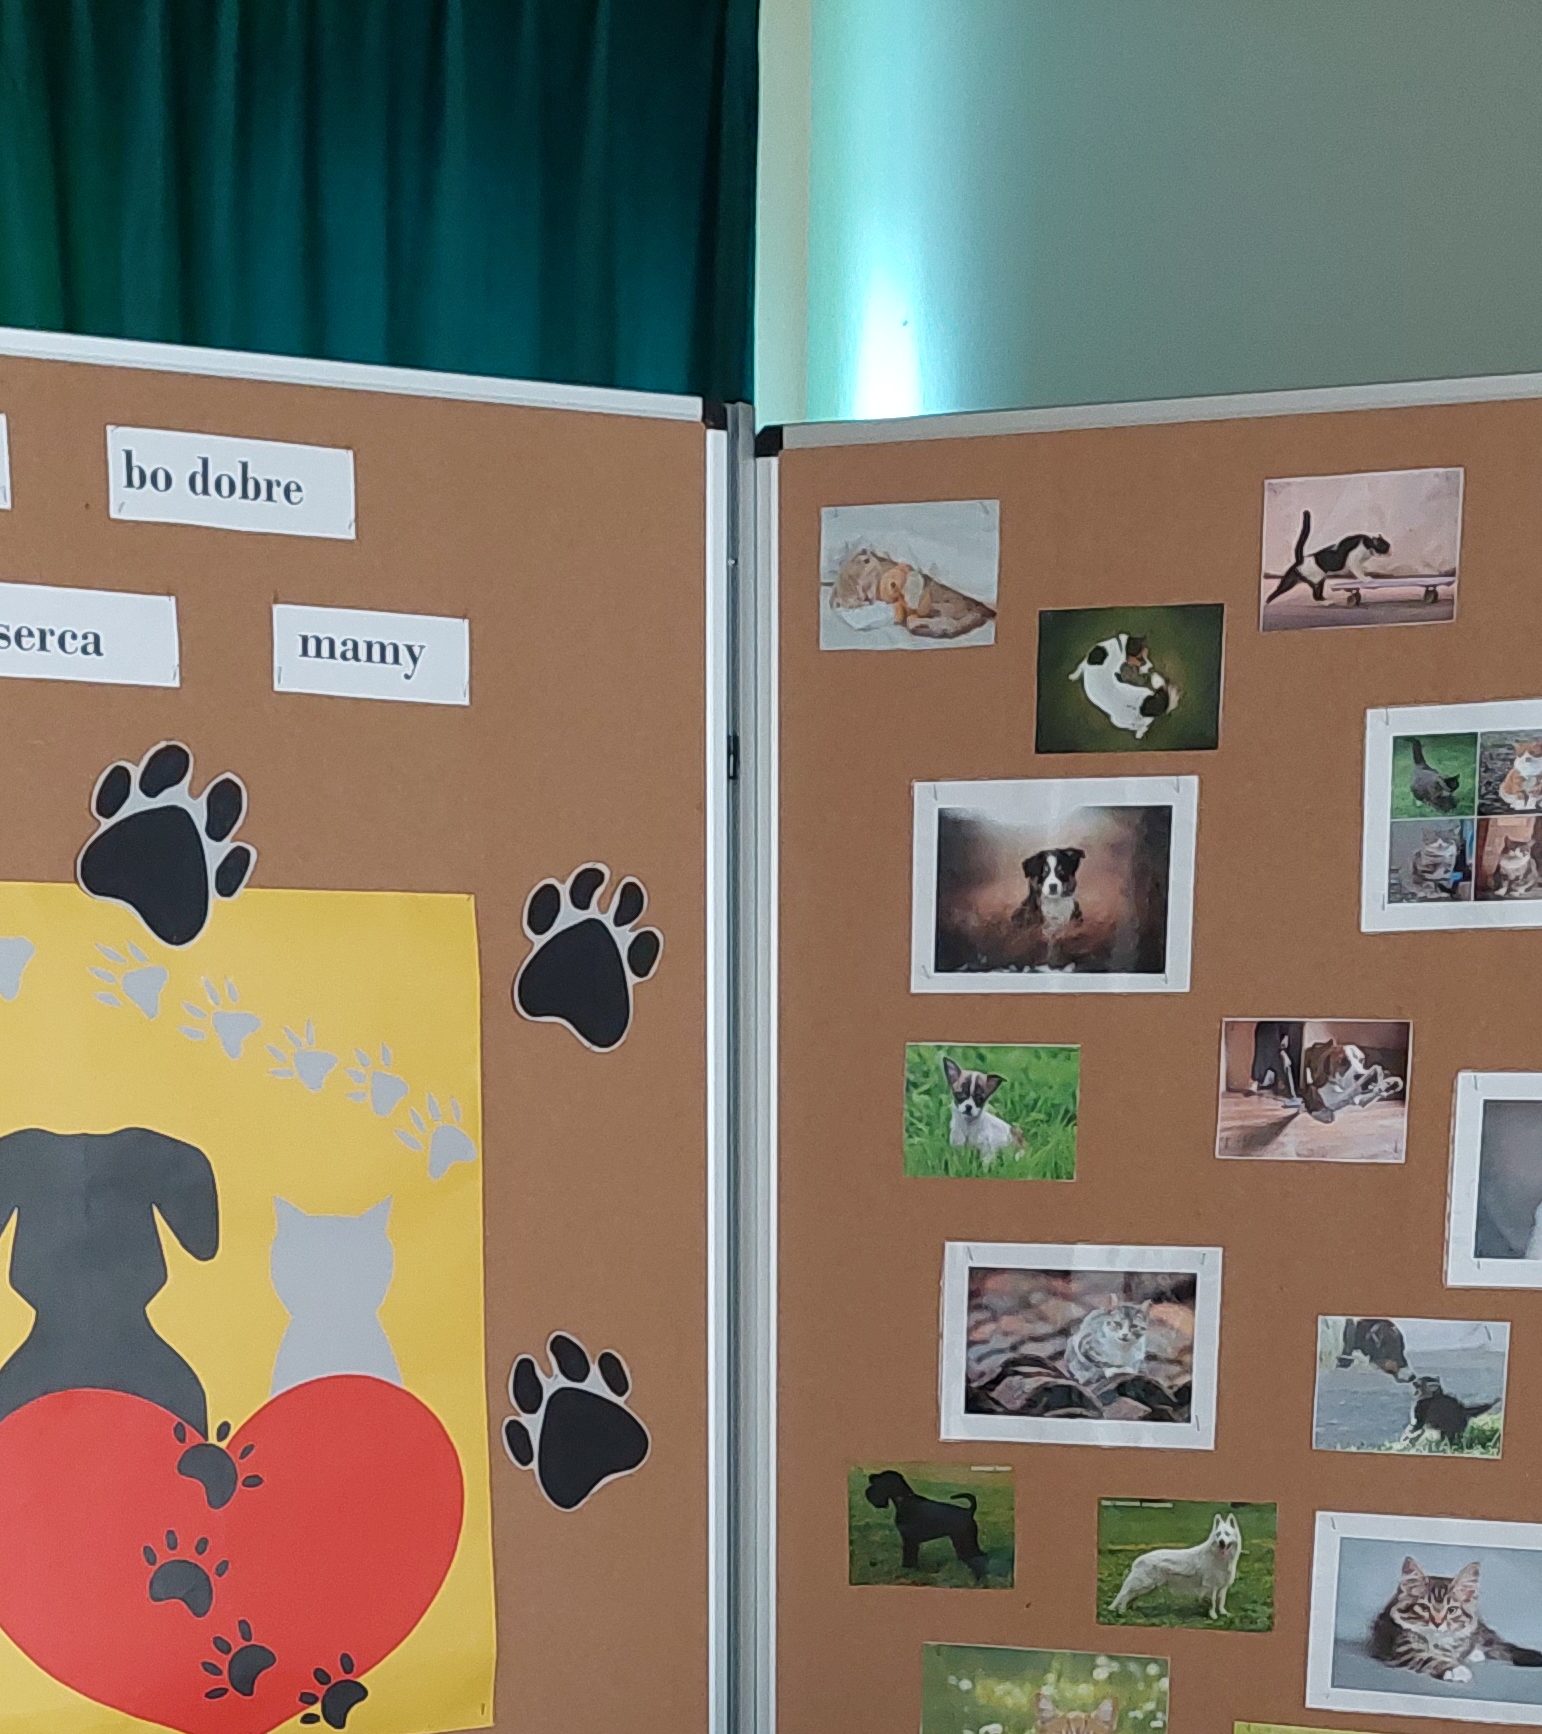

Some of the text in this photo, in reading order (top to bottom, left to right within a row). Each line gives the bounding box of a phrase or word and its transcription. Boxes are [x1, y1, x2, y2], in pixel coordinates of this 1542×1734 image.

[122, 449, 307, 508] bo dobre
[298, 624, 427, 677] mamy
